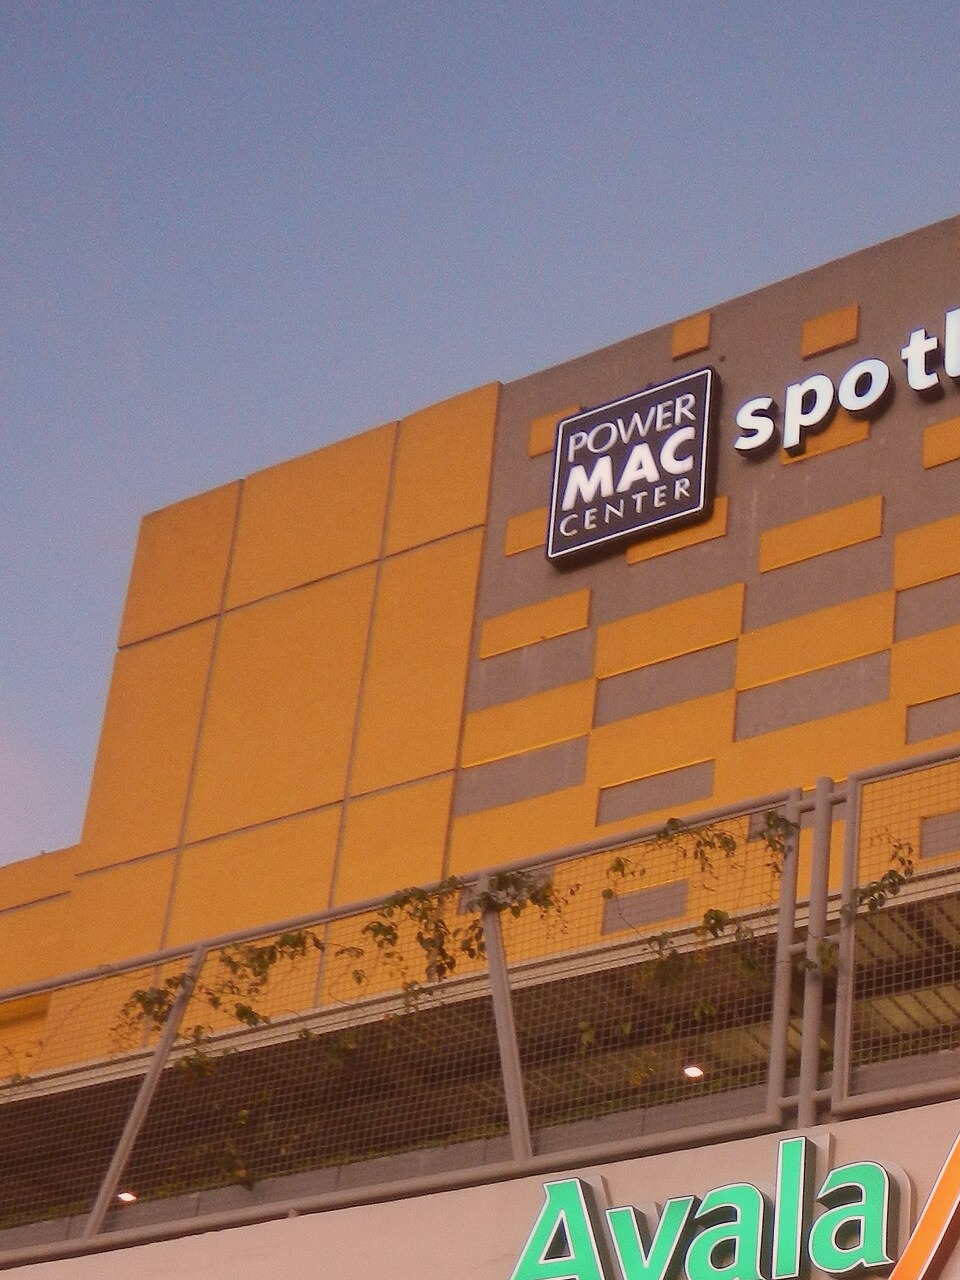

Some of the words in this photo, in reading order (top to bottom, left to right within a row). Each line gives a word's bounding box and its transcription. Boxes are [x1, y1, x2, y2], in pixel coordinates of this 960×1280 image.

[567, 393, 697, 463] POWER
[561, 426, 696, 512] MAC
[559, 477, 692, 537] CENTER
